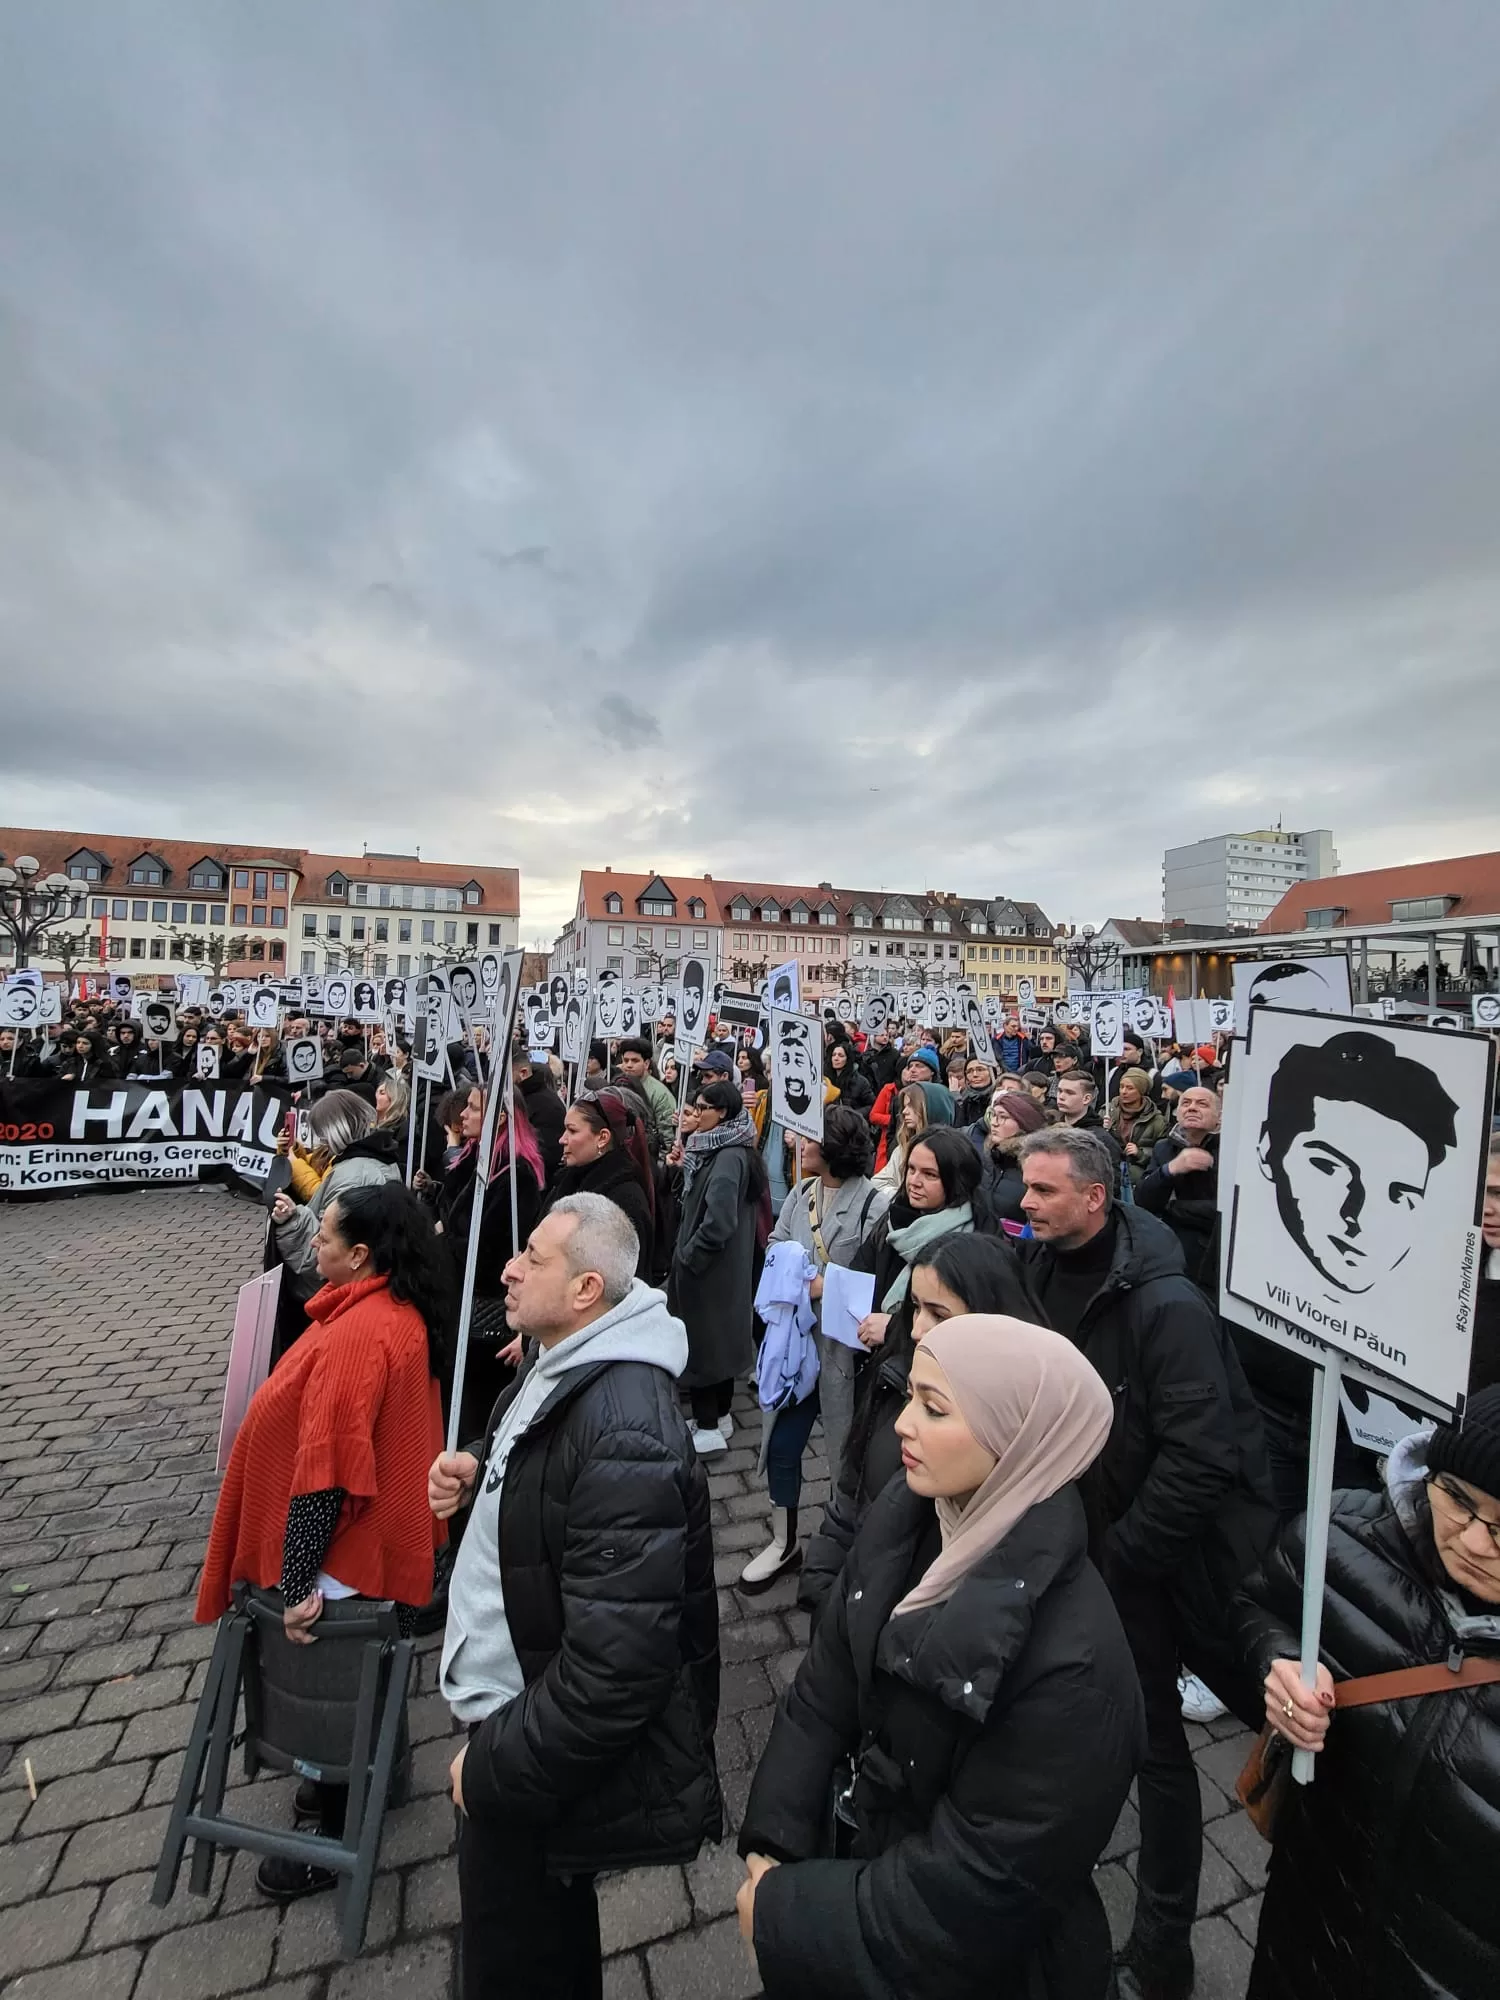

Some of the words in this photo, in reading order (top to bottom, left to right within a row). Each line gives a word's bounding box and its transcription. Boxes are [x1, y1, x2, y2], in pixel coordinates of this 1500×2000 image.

[28, 1148, 159, 1164] Erinnerung,
[20, 1163, 194, 1185] Konsequenzen!
[1455, 1231, 1476, 1333] #SayTheirNames
[1266, 1281, 1291, 1307] Vili
[1296, 1295, 1348, 1336] Viorel
[1353, 1325, 1407, 1366] Păun
[1355, 1427, 1396, 1449] Mercedes
